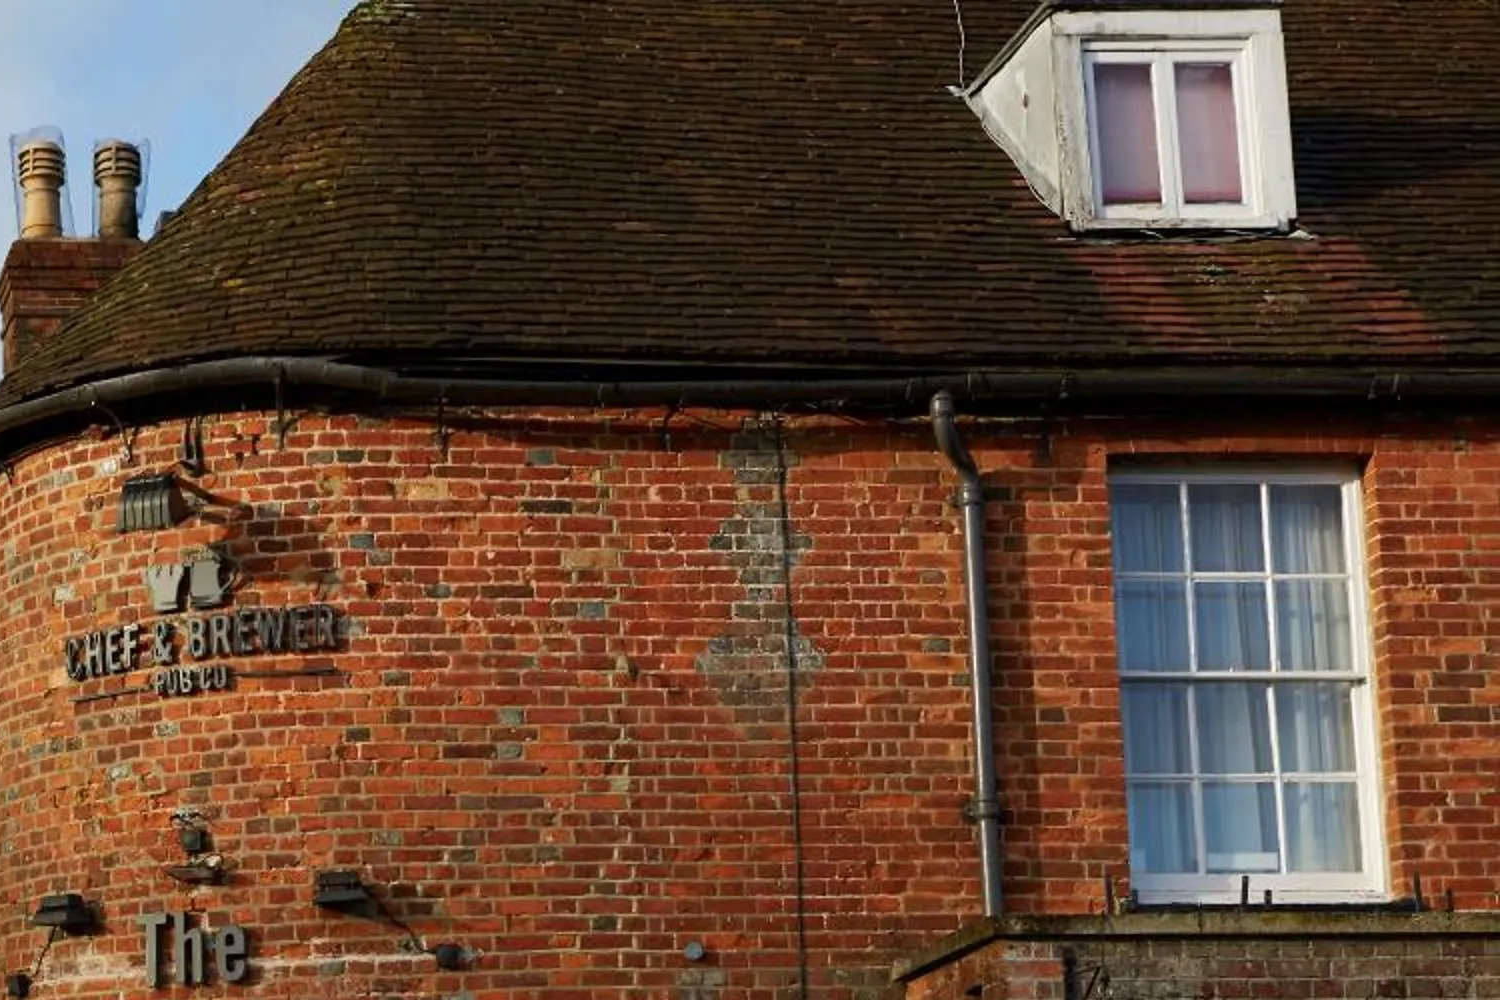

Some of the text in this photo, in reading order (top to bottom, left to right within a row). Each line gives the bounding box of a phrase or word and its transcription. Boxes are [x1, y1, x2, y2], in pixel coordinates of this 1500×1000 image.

[66, 604, 337, 680] CHEF & BREWER
[154, 665, 228, 695] PUB CO
[138, 912, 246, 988] The
